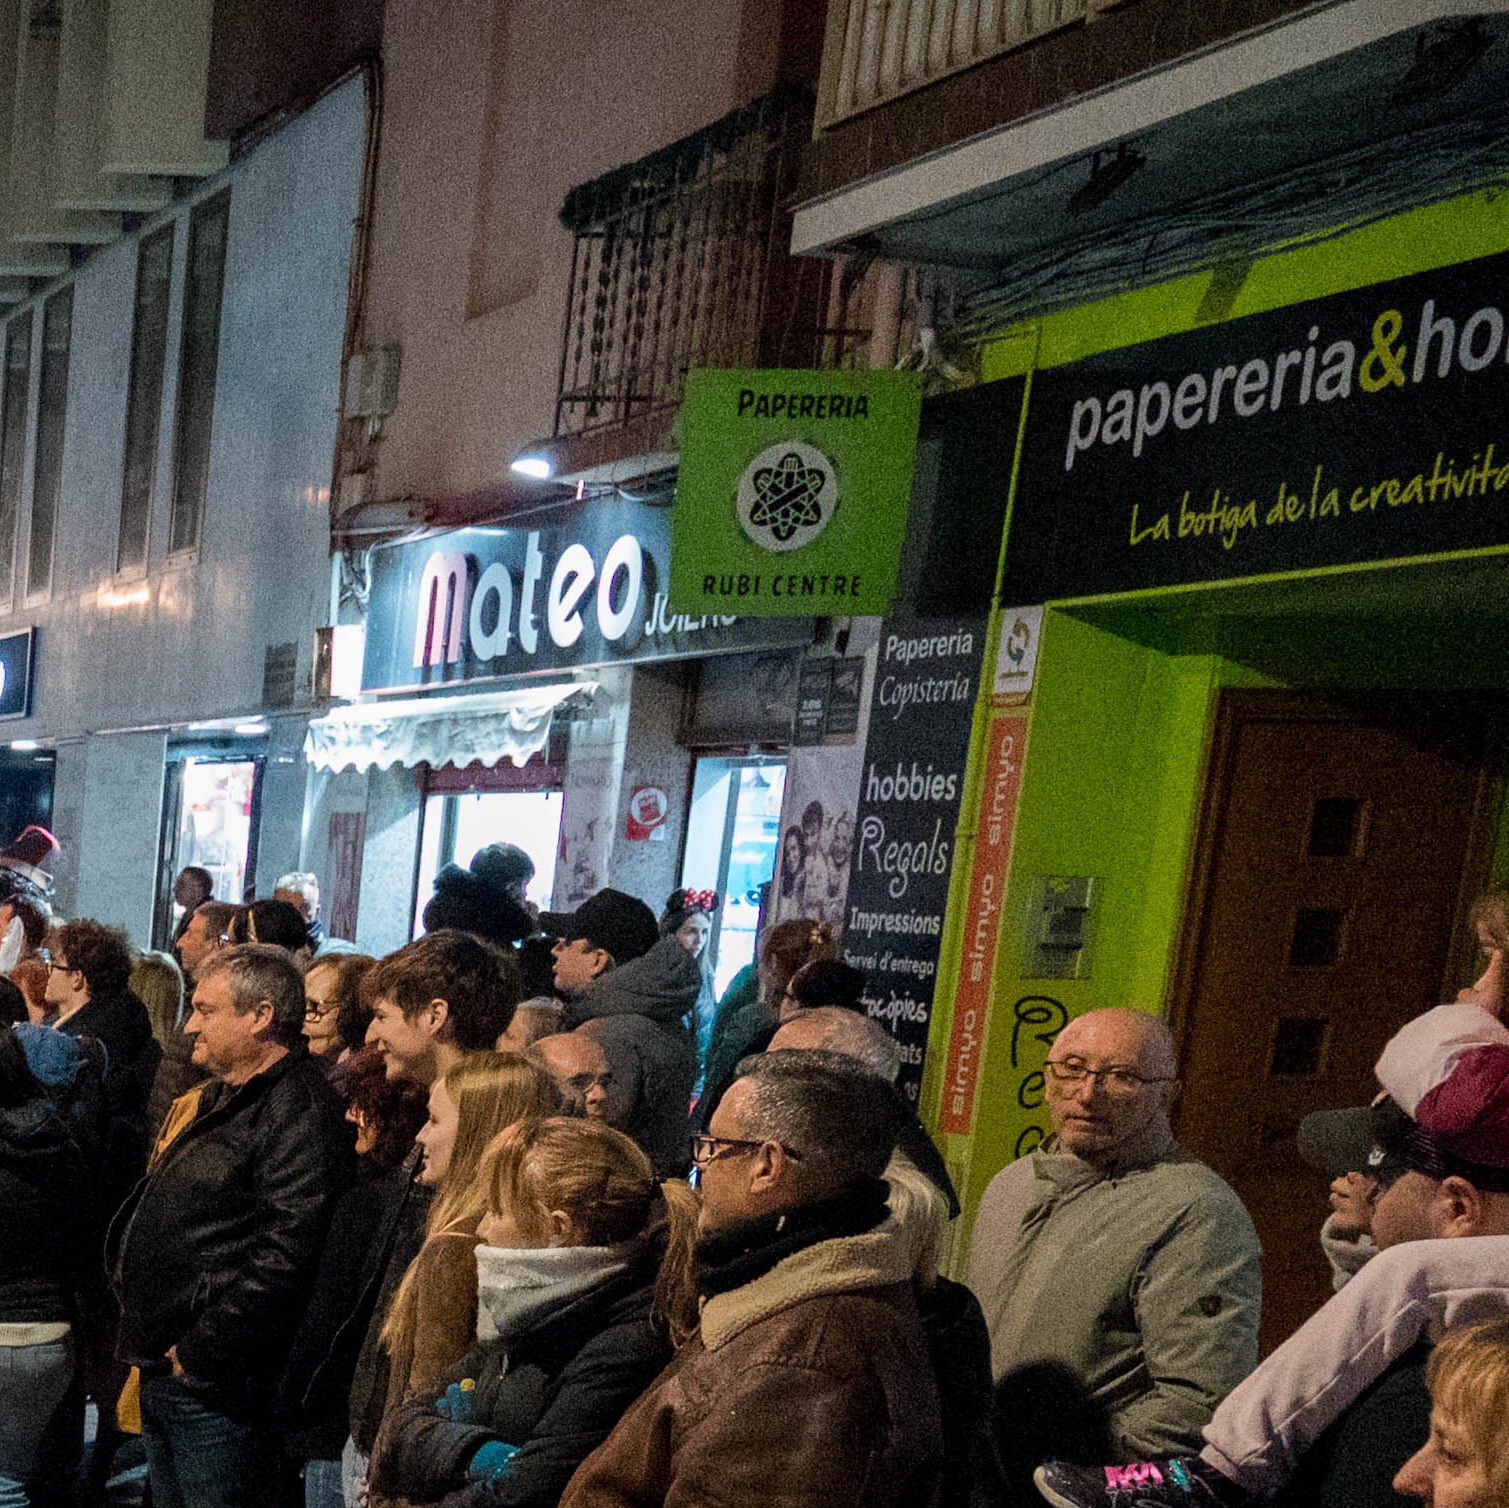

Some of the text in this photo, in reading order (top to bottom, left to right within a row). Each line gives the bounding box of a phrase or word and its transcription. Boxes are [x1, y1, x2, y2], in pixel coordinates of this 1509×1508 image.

[738, 389, 869, 419] PAPERERIA
[1065, 299, 1509, 471] papereria&ho
[1130, 504, 1169, 545] La
[1178, 489, 1257, 549] botiga
[1266, 482, 1306, 525] de
[1309, 465, 1340, 519] la
[703, 574, 862, 597] RUBI CENTRE
[885, 628, 973, 665] Papereria
[880, 671, 970, 720] Copisteria
[866, 762, 957, 802] hobbies
[987, 736, 1014, 846] simyo
[858, 816, 949, 898] Regals
[849, 907, 941, 938] Impressions
[969, 874, 997, 981] simyo
[952, 1009, 977, 1116] simyo
